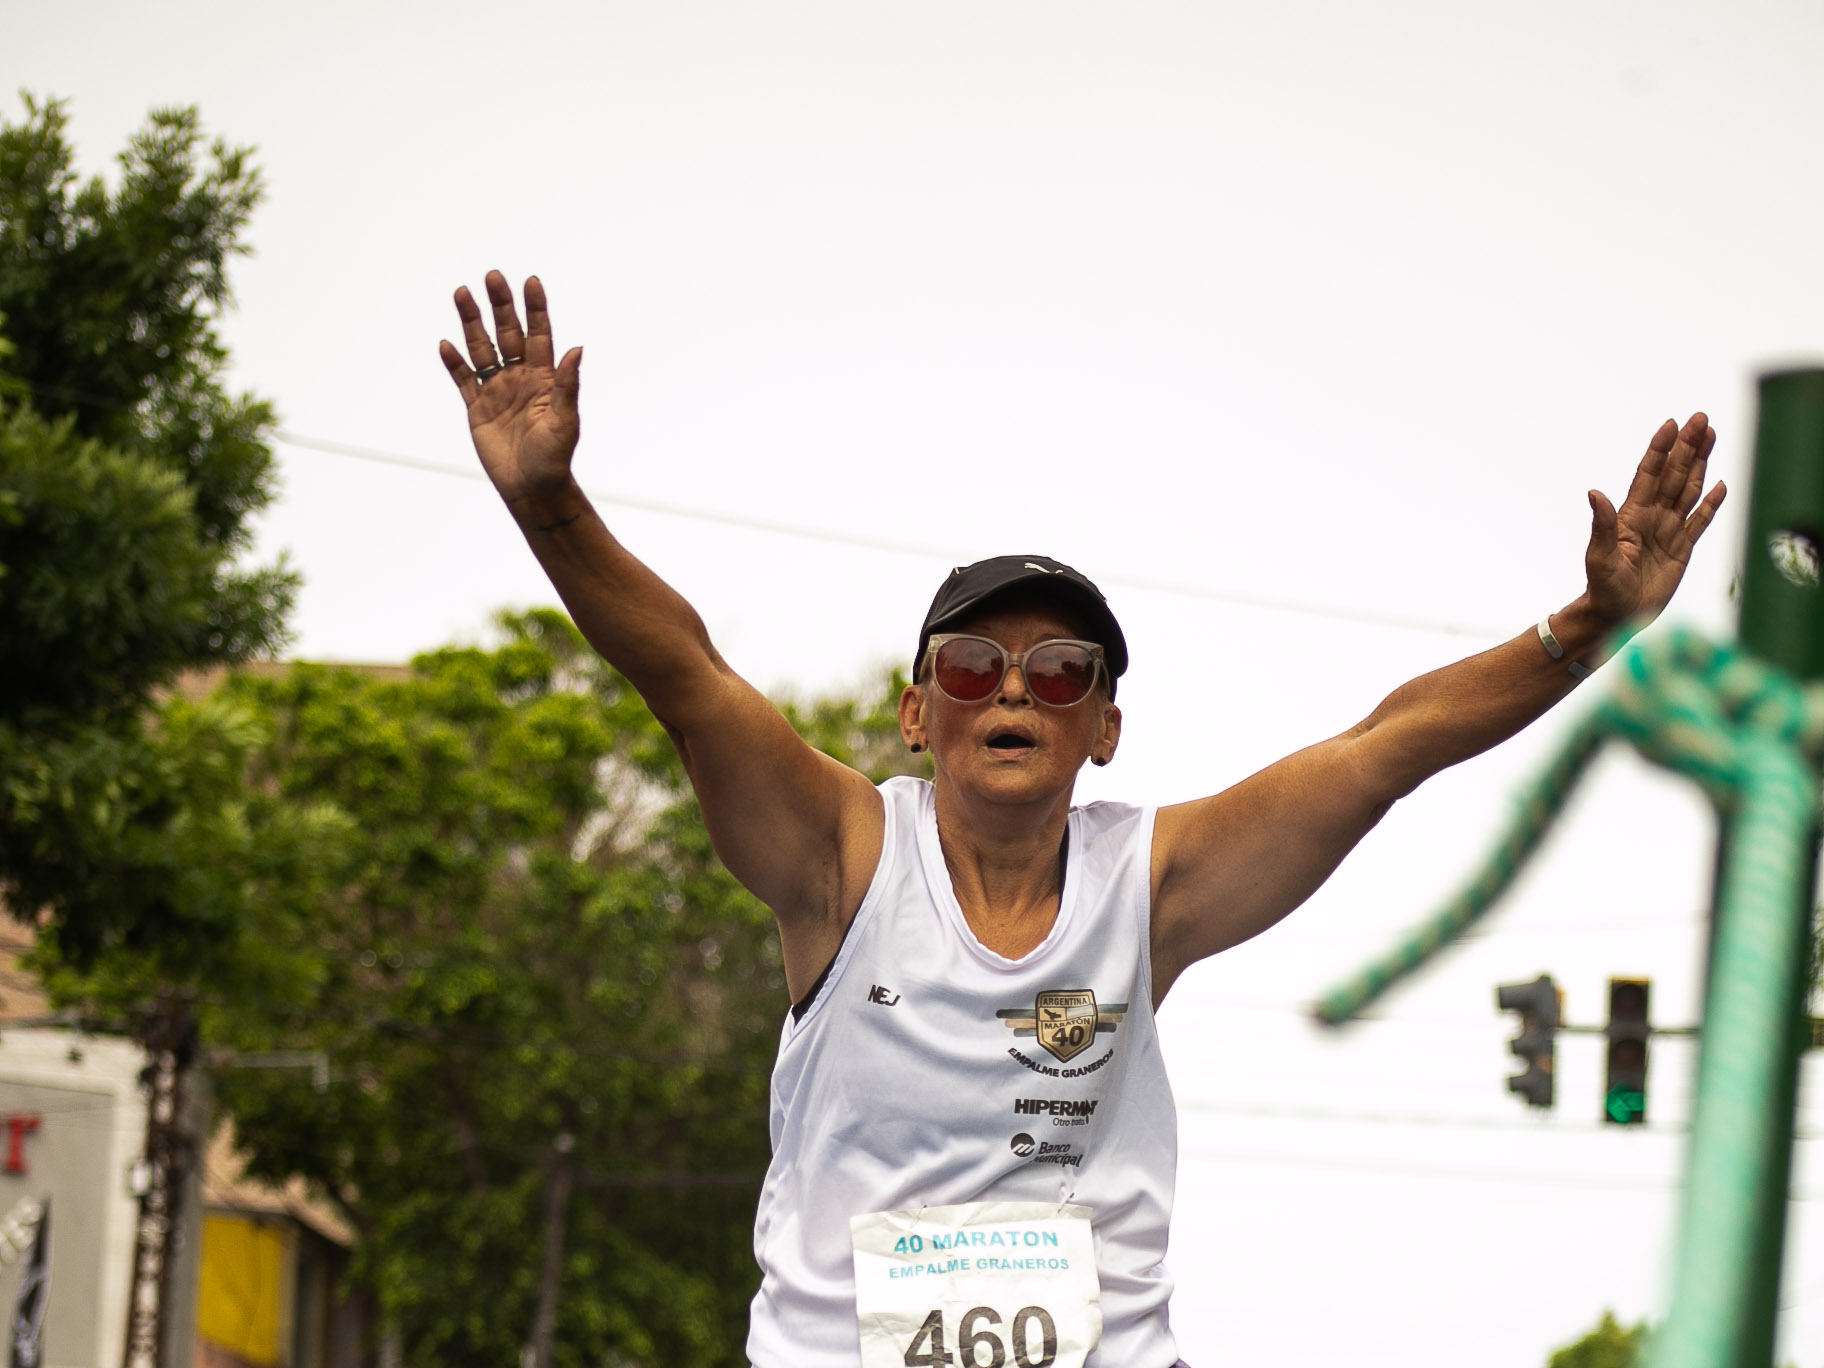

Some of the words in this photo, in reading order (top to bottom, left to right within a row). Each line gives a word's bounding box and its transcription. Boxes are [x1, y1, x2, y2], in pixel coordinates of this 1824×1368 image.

[867, 984, 901, 1007] NEJ
[1043, 997, 1088, 1006] ARGENTINA
[1051, 1025, 1085, 1047] 40
[1007, 1047, 1059, 1078] EMPALME
[1061, 1047, 1114, 1078] GRANEROS
[1038, 1141, 1072, 1155] Banco
[894, 1234, 924, 1255] 40
[932, 1231, 1060, 1250] MARATON
[889, 1258, 971, 1279] EMPALME
[976, 1257, 1070, 1271] GRANEROS
